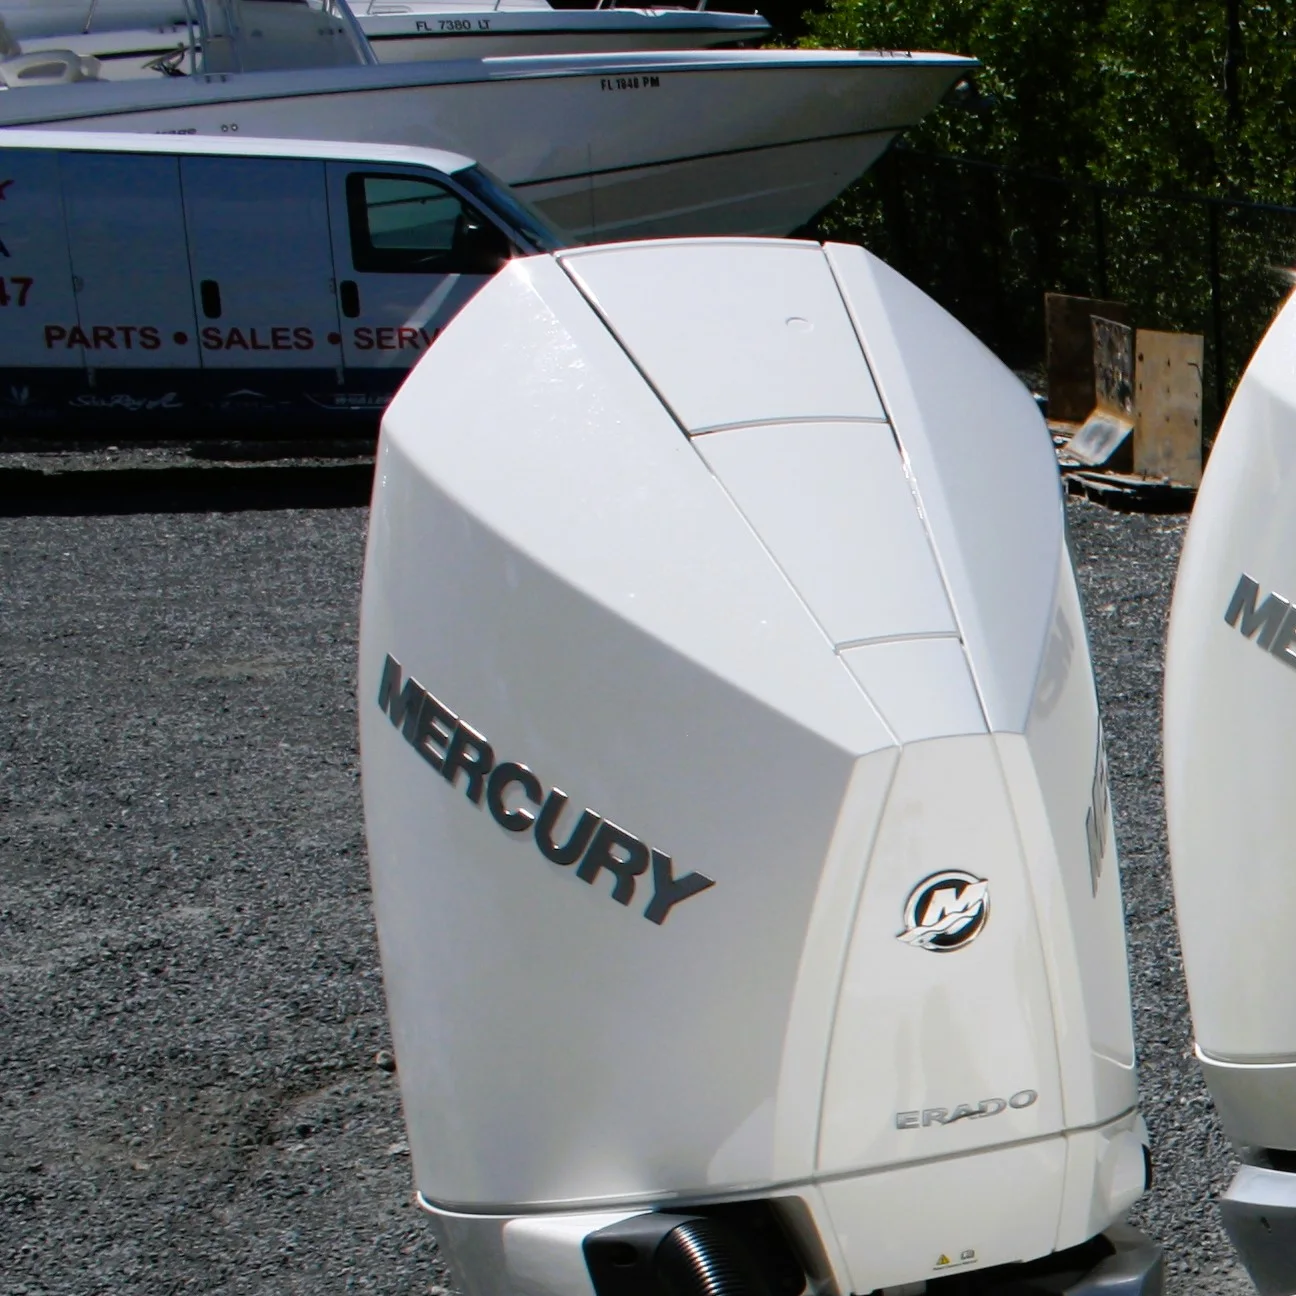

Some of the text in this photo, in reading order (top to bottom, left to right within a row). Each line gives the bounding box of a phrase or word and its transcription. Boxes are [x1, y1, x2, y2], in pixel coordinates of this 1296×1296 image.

[415, 19, 491, 32] FL 7380 LT
[600, 78, 614, 91] FL
[44, 325, 162, 350] PARTS
[202, 326, 314, 350] SALES
[377, 651, 717, 927] MERCURY
[896, 1089, 1038, 1130] ERADO
